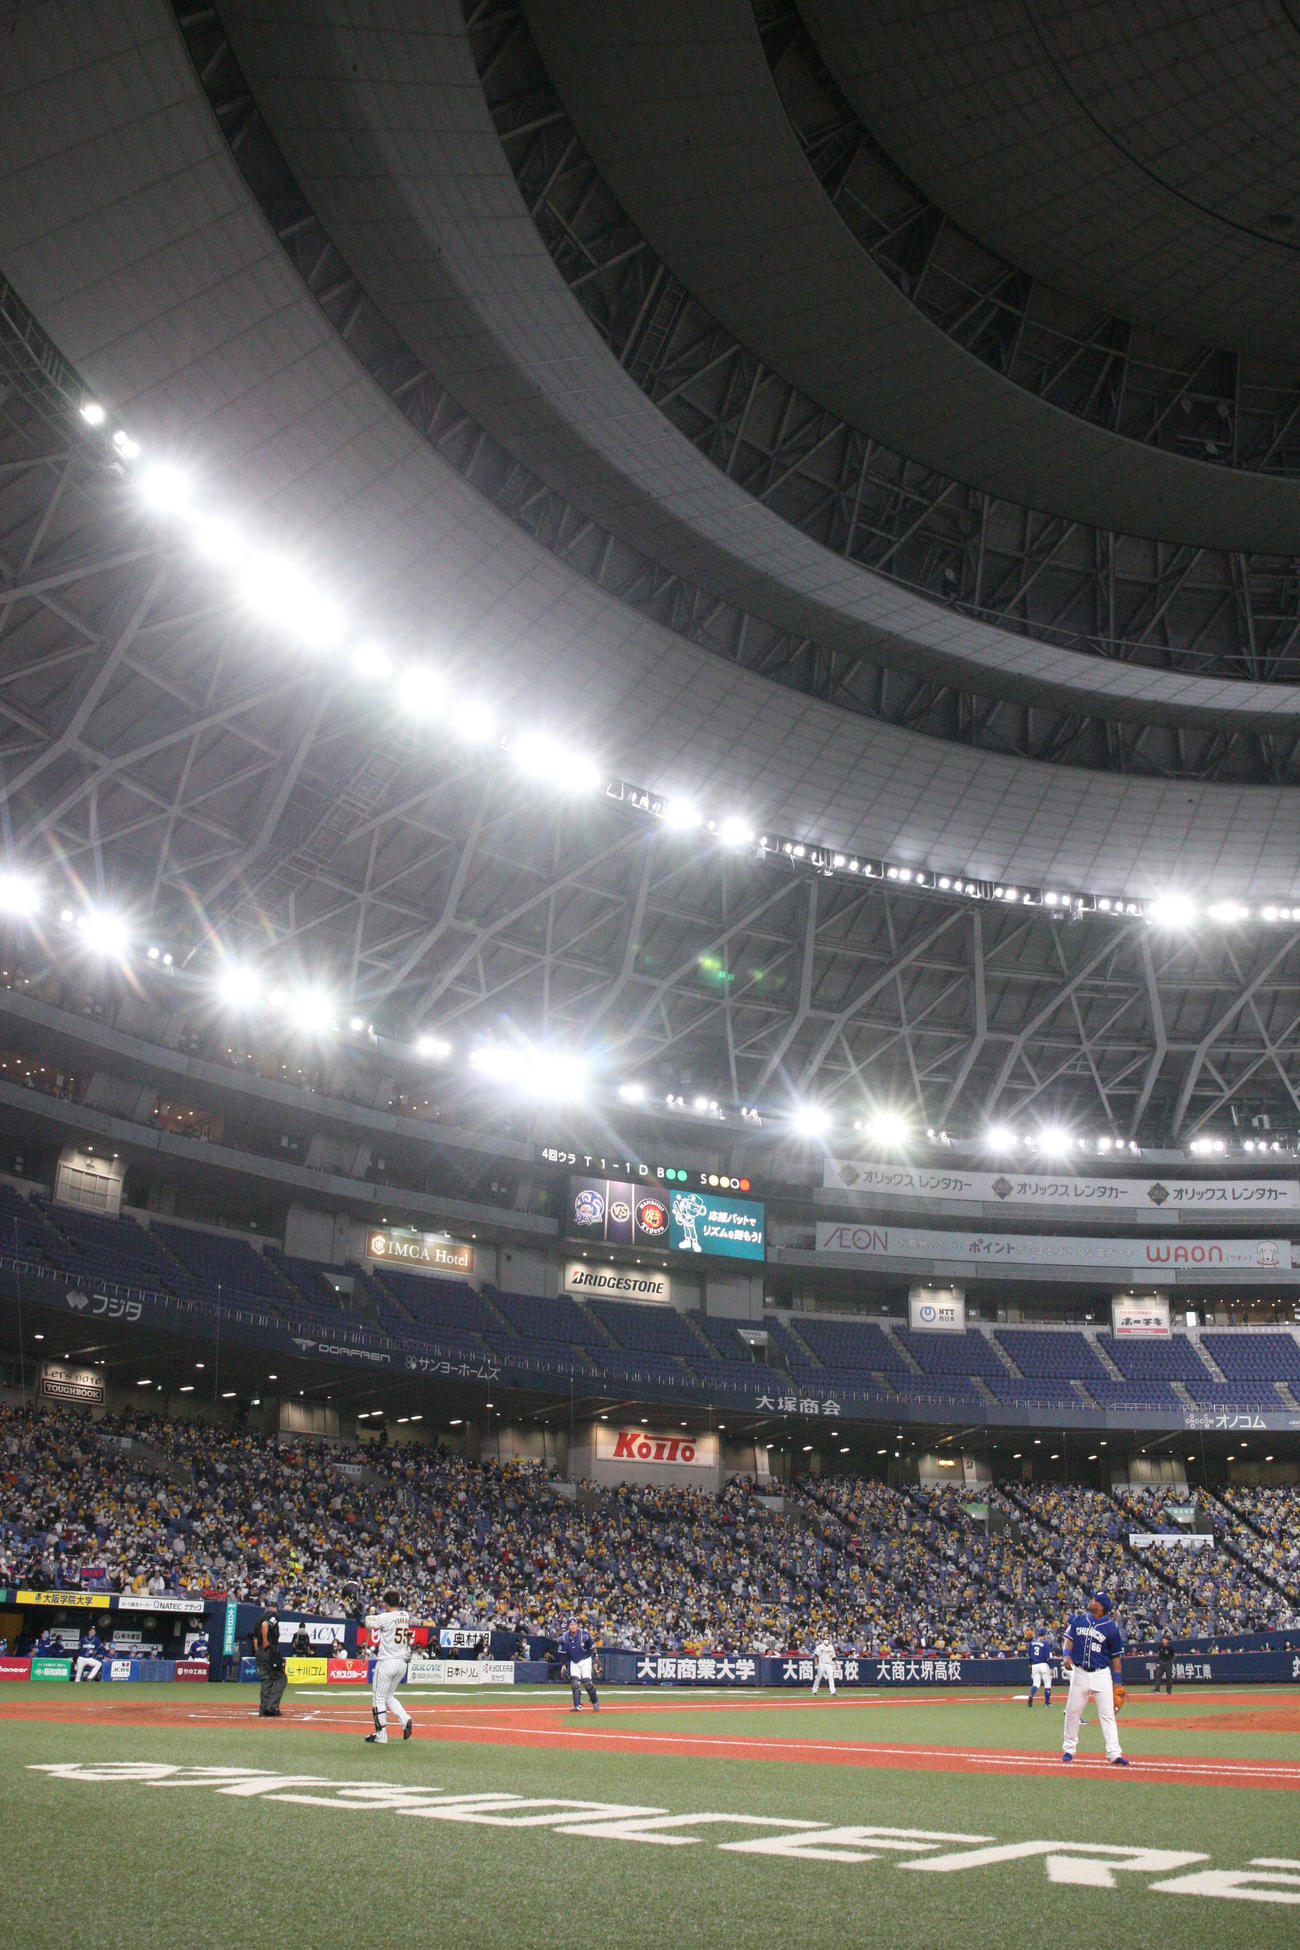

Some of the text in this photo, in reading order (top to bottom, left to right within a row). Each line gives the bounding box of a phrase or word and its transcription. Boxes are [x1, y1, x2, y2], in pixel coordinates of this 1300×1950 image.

[542, 1148, 576, 1165] 4回ウラ
[584, 1156, 592, 1167] T
[639, 1164, 648, 1175] D
[657, 1167, 665, 1178] B
[700, 1173, 707, 1184] S
[863, 1171, 972, 1192] オリックス レンタカー
[1016, 1182, 1128, 1199] オリックス レンタカー
[1173, 1187, 1287, 1201] オリックス レンタカー
[708, 1210, 757, 1227] 応援バットで
[388, 1240, 469, 1267] IMCA Hotel
[968, 1239, 1015, 1254] ポイント
[1146, 1245, 1223, 1263] WAON
[571, 1271, 664, 1294] BRIDGESTONE
[92, 1294, 143, 1321] フジタ
[938, 1308, 955, 1316] NTT
[418, 1357, 501, 1381] サンヨーホームズ
[46, 1383, 100, 1398] TOUGHBOOK
[756, 1394, 841, 1416] 大塚商会
[1215, 1413, 1267, 1429] オノコム
[43, 1594, 94, 1606] 大阪学院大学
[309, 1627, 340, 1640] ACN
[0, 1665, 28, 1673] ioneer
[296, 1666, 325, 1676] 十川ゴム
[447, 1667, 478, 1678] 日本トリム
[637, 1658, 755, 1680] 大阪商業大学
[783, 1660, 859, 1681] 大商高校
[877, 1660, 962, 1681] 大商大堺高校
